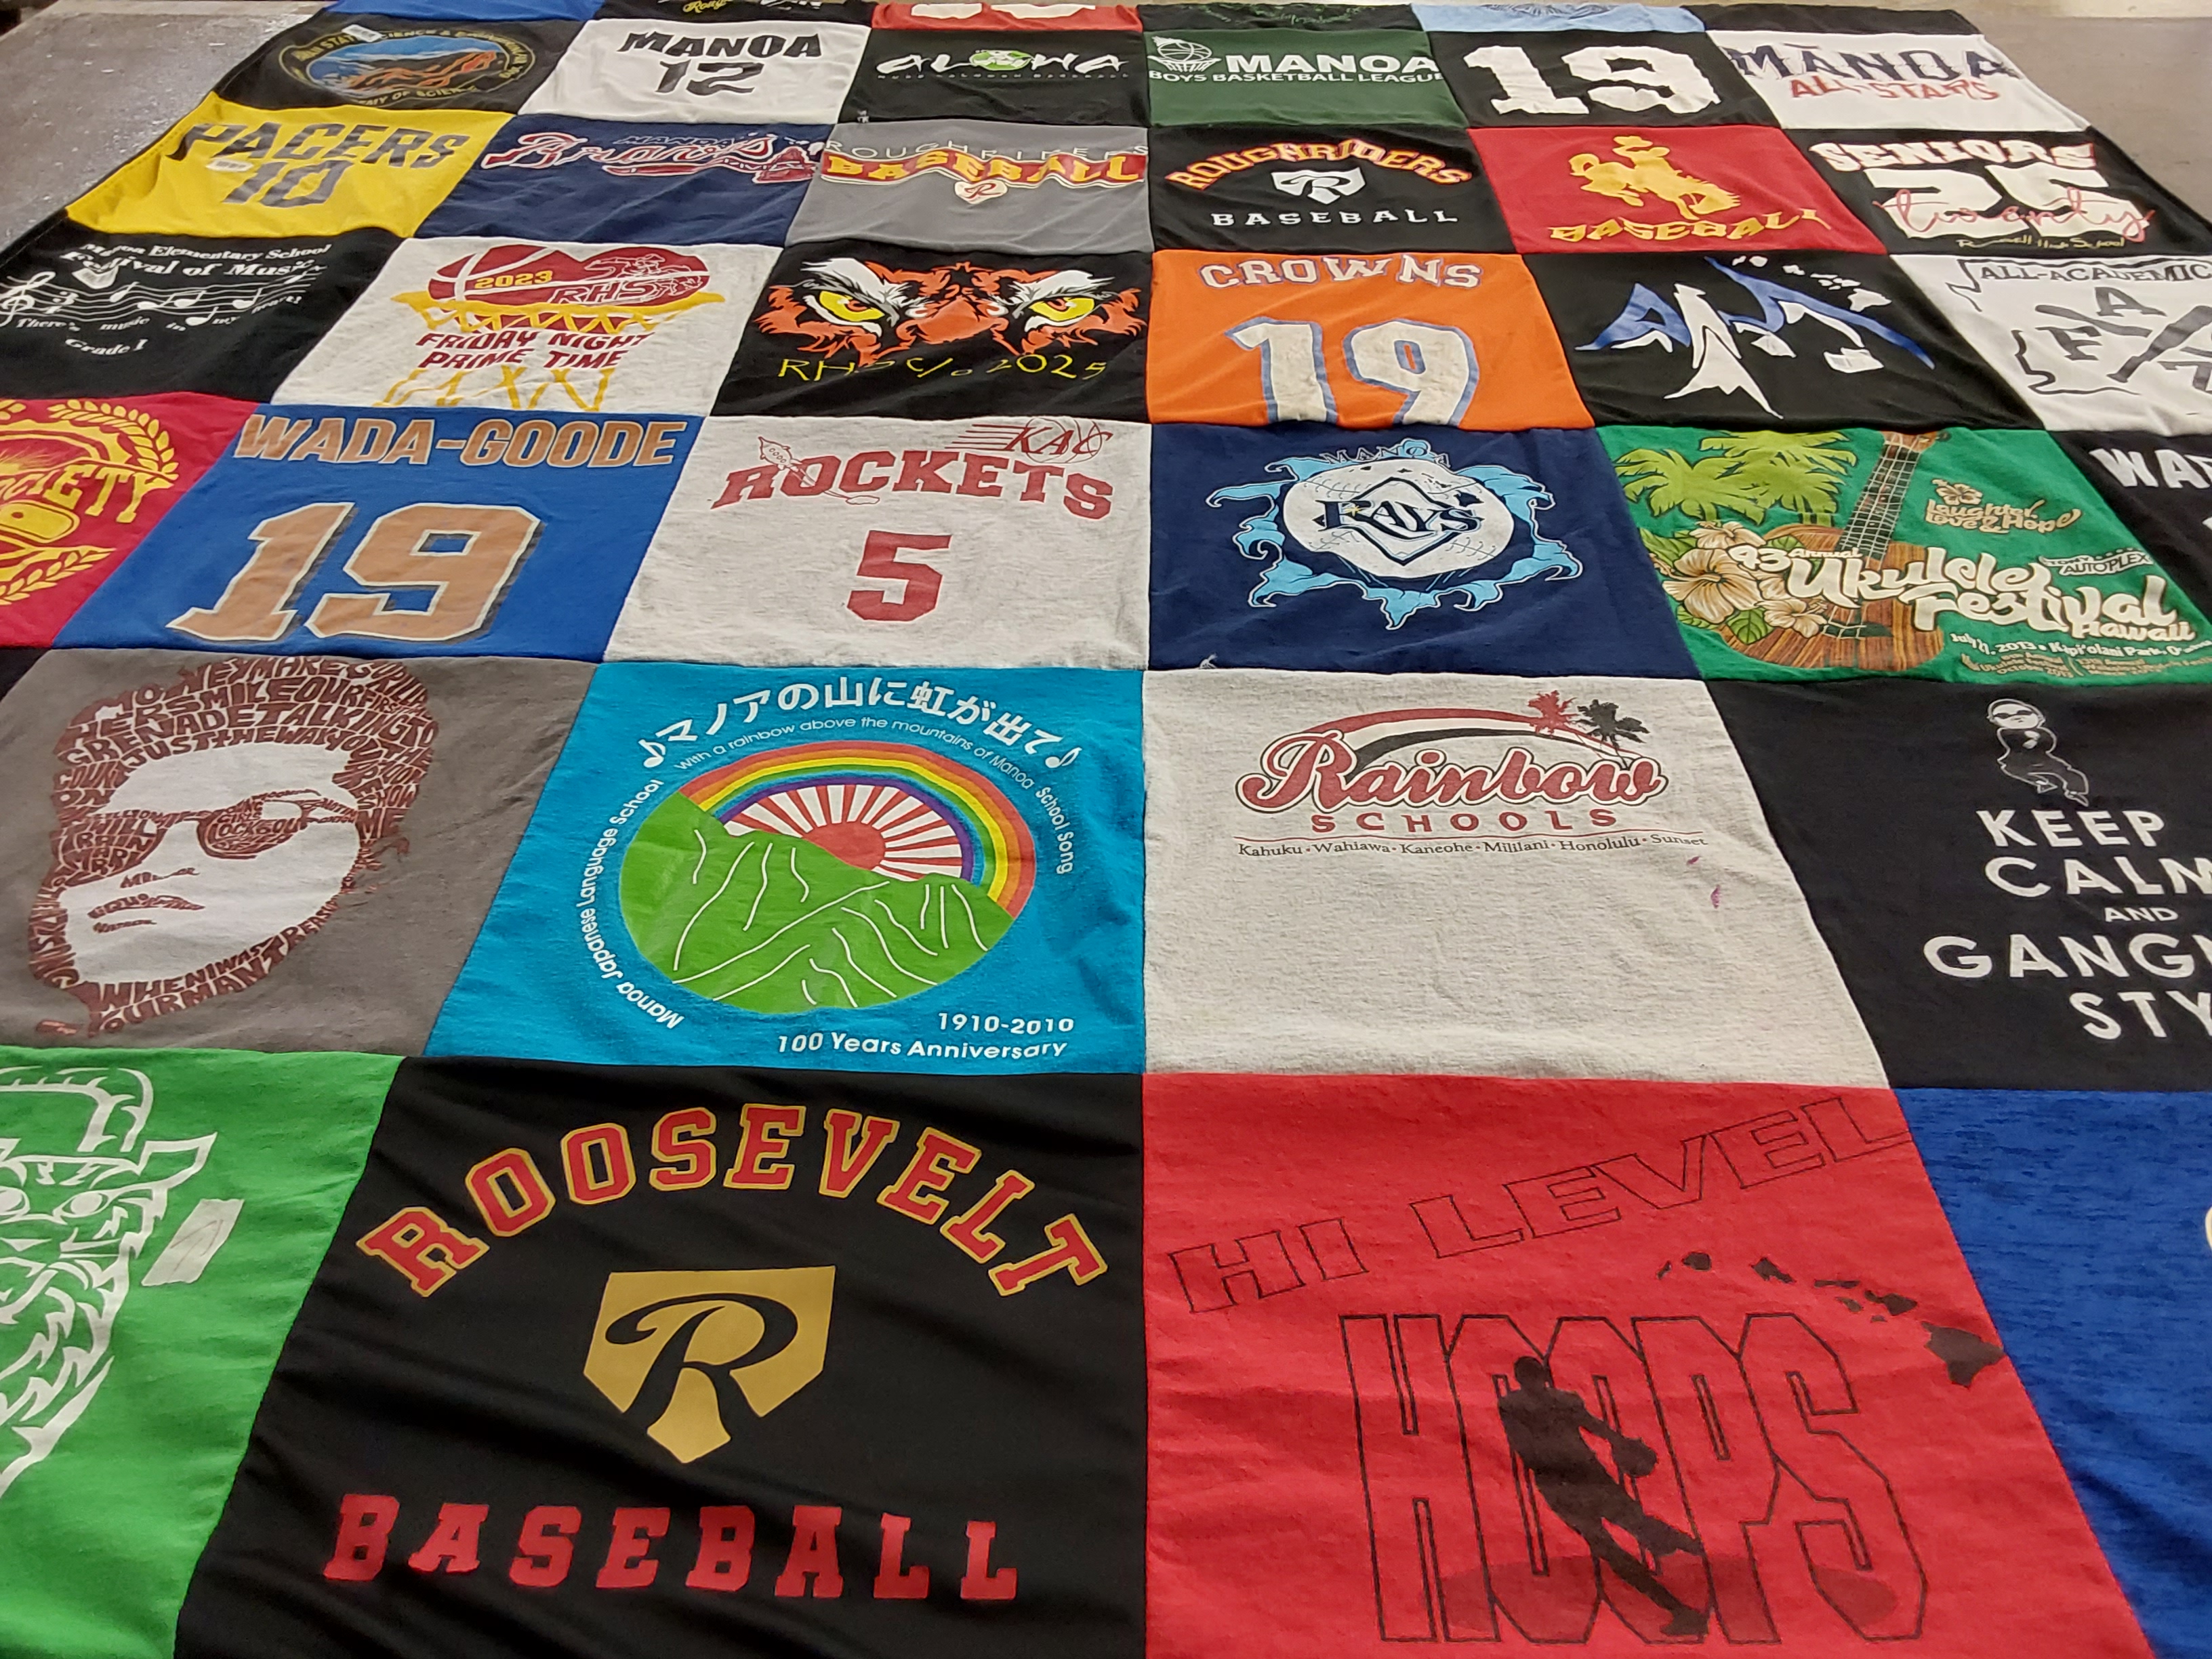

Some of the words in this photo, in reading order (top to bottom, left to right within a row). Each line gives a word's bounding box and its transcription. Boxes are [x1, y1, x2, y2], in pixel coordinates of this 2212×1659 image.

[617, 30, 823, 58] MANOA
[655, 59, 765, 96] 12
[1148, 70, 1208, 83] BOYS
[1212, 72, 1354, 83] BASKETBALL
[1357, 72, 1445, 83] LEAGUE
[1225, 54, 1440, 74] MANOA
[1462, 45, 1722, 115] 19
[169, 121, 470, 169] PACERS
[1807, 138, 2096, 171] SENIORS
[828, 147, 1142, 183] BASEBALL
[1164, 138, 1474, 191] ROUGHRIDERS
[222, 159, 354, 208] 10
[1862, 161, 2150, 240] 25
[1210, 209, 1459, 227] BASEBALL
[1548, 207, 1832, 243] BASEBALL
[148, 245, 263, 262] Elementary
[264, 243, 333, 261] School
[182, 262, 222, 276] of
[224, 258, 313, 276] Music
[1198, 253, 1484, 289] CROWNS
[474, 270, 554, 289] 2023
[1980, 264, 2212, 282] ALL-ACADEMIC
[548, 281, 655, 305] RHS
[16, 317, 81, 332] There's
[99, 316, 151, 331] music
[165, 321, 187, 332] in
[211, 314, 239, 325] my
[415, 329, 541, 351] FRIDAY
[546, 331, 656, 350] NIGHT
[65, 338, 131, 356] Grade
[416, 347, 535, 369] PRIME
[543, 349, 630, 369] TIME
[986, 353, 1108, 380] 2025
[1223, 315, 1480, 426] 19
[232, 413, 688, 468] WADA-GOODE
[1319, 443, 1450, 468] MANOA
[0, 463, 175, 523] CIETY
[710, 449, 1114, 520] ROCKETS
[1313, 499, 1486, 540] RAYS
[1788, 546, 1864, 558] Annual
[2063, 553, 2152, 574] AUTOPLEX
[165, 501, 547, 644] 19
[846, 529, 954, 623] 5
[1787, 546, 2053, 609] Ukulele
[1898, 573, 2178, 632] Festival
[1995, 641, 2039, 654] 2013
[2071, 617, 2197, 642] Hawaii
[655, 676, 1063, 755] マノアの山に虹が出て
[122, 732, 217, 769] JUST
[712, 745, 727, 756] a
[727, 724, 796, 750] rainbow
[799, 716, 856, 731] above
[861, 716, 888, 729] the
[891, 720, 974, 752] mountains
[973, 746, 994, 759] of
[989, 755, 1036, 790] Manoa
[1235, 730, 1669, 814] Rainbow
[609, 779, 665, 825] School
[1035, 786, 1071, 832] School
[1056, 831, 1075, 875] Song
[1309, 808, 1618, 834] SCHOOLS
[1975, 809, 2165, 848] KEEP
[1237, 842, 1303, 858] Kahuku
[1311, 841, 1392, 855] Wahiawa
[1399, 841, 1474, 855] Kaneohe
[1482, 840, 1550, 854] Mililani
[1559, 836, 1642, 852] Honolulu
[1650, 832, 1709, 847] Sunset
[576, 827, 619, 908] Language
[2104, 906, 2179, 923] AND
[579, 907, 624, 980] Japanese
[616, 981, 685, 1029] Manoa
[938, 1012, 1075, 1036] 1910-2010
[778, 1031, 823, 1053] 100
[831, 1031, 902, 1055] Years
[906, 1040, 1068, 1059] Anniversary
[356, 1103, 1108, 1298] ROOSEVELT
[1167, 1217, 1370, 1314] HI
[1408, 1094, 1913, 1261] LEVEL
[605, 1290, 800, 1443] R
[1339, 1311, 1930, 1647] HOOPS
[322, 1492, 1019, 1602] BASEBALL
